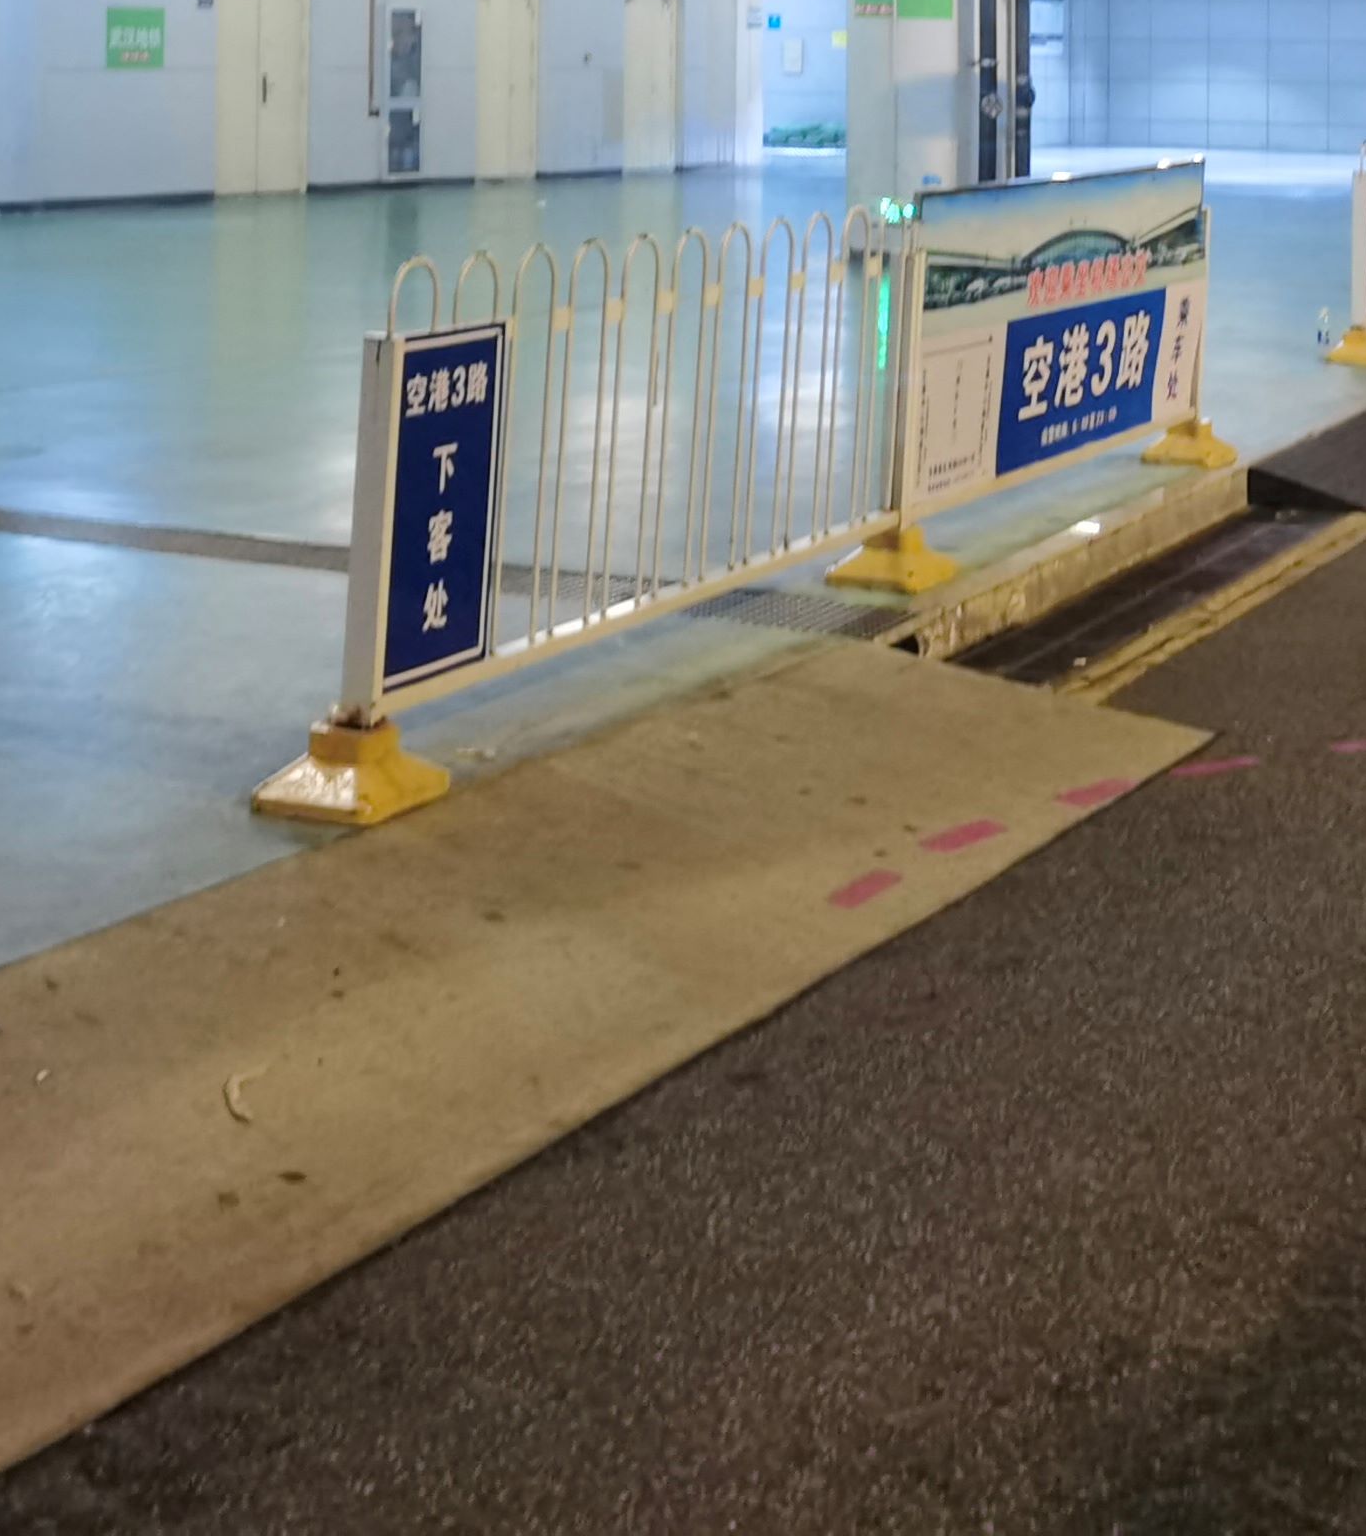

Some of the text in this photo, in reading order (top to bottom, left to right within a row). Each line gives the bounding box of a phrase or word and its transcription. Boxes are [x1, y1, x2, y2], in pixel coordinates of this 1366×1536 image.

[405, 360, 489, 417] 空港3路
[1017, 310, 1152, 422] 空港3路
[422, 441, 459, 633] 下客处
